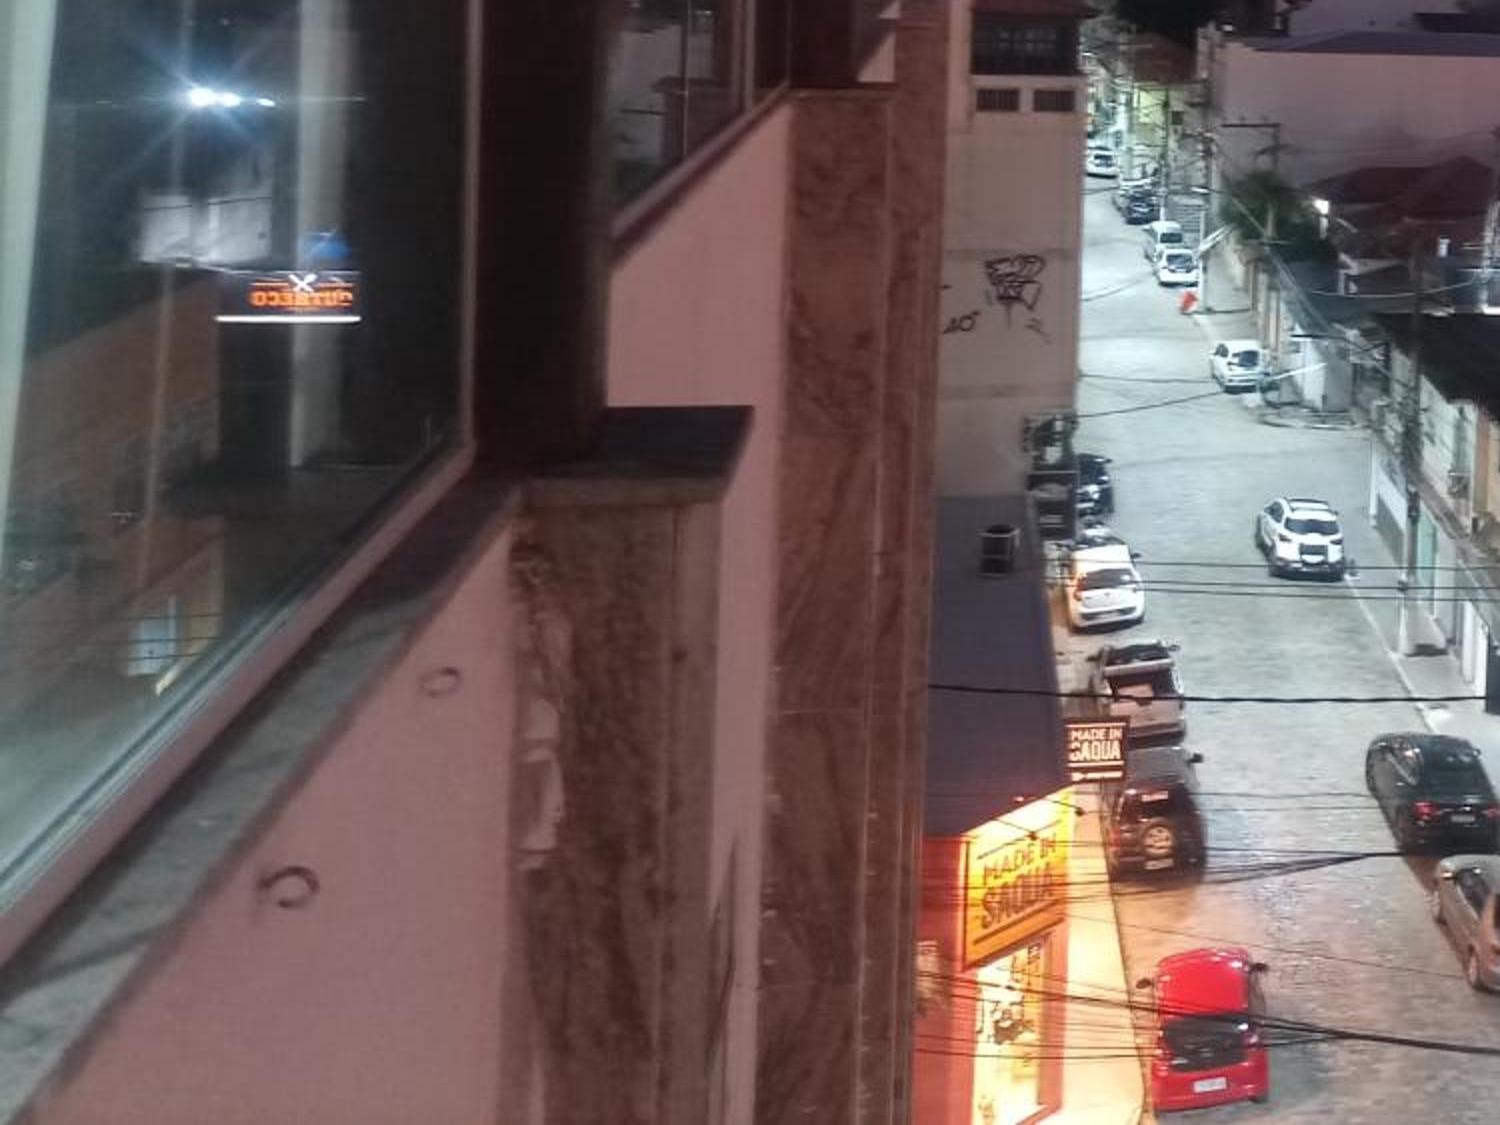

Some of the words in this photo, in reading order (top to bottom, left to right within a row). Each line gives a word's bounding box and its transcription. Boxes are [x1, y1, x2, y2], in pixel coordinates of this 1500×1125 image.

[1071, 729, 1106, 741] MADE
[1109, 728, 1122, 739] IN
[983, 841, 1035, 887] MADE
[1040, 832, 1057, 859] IN
